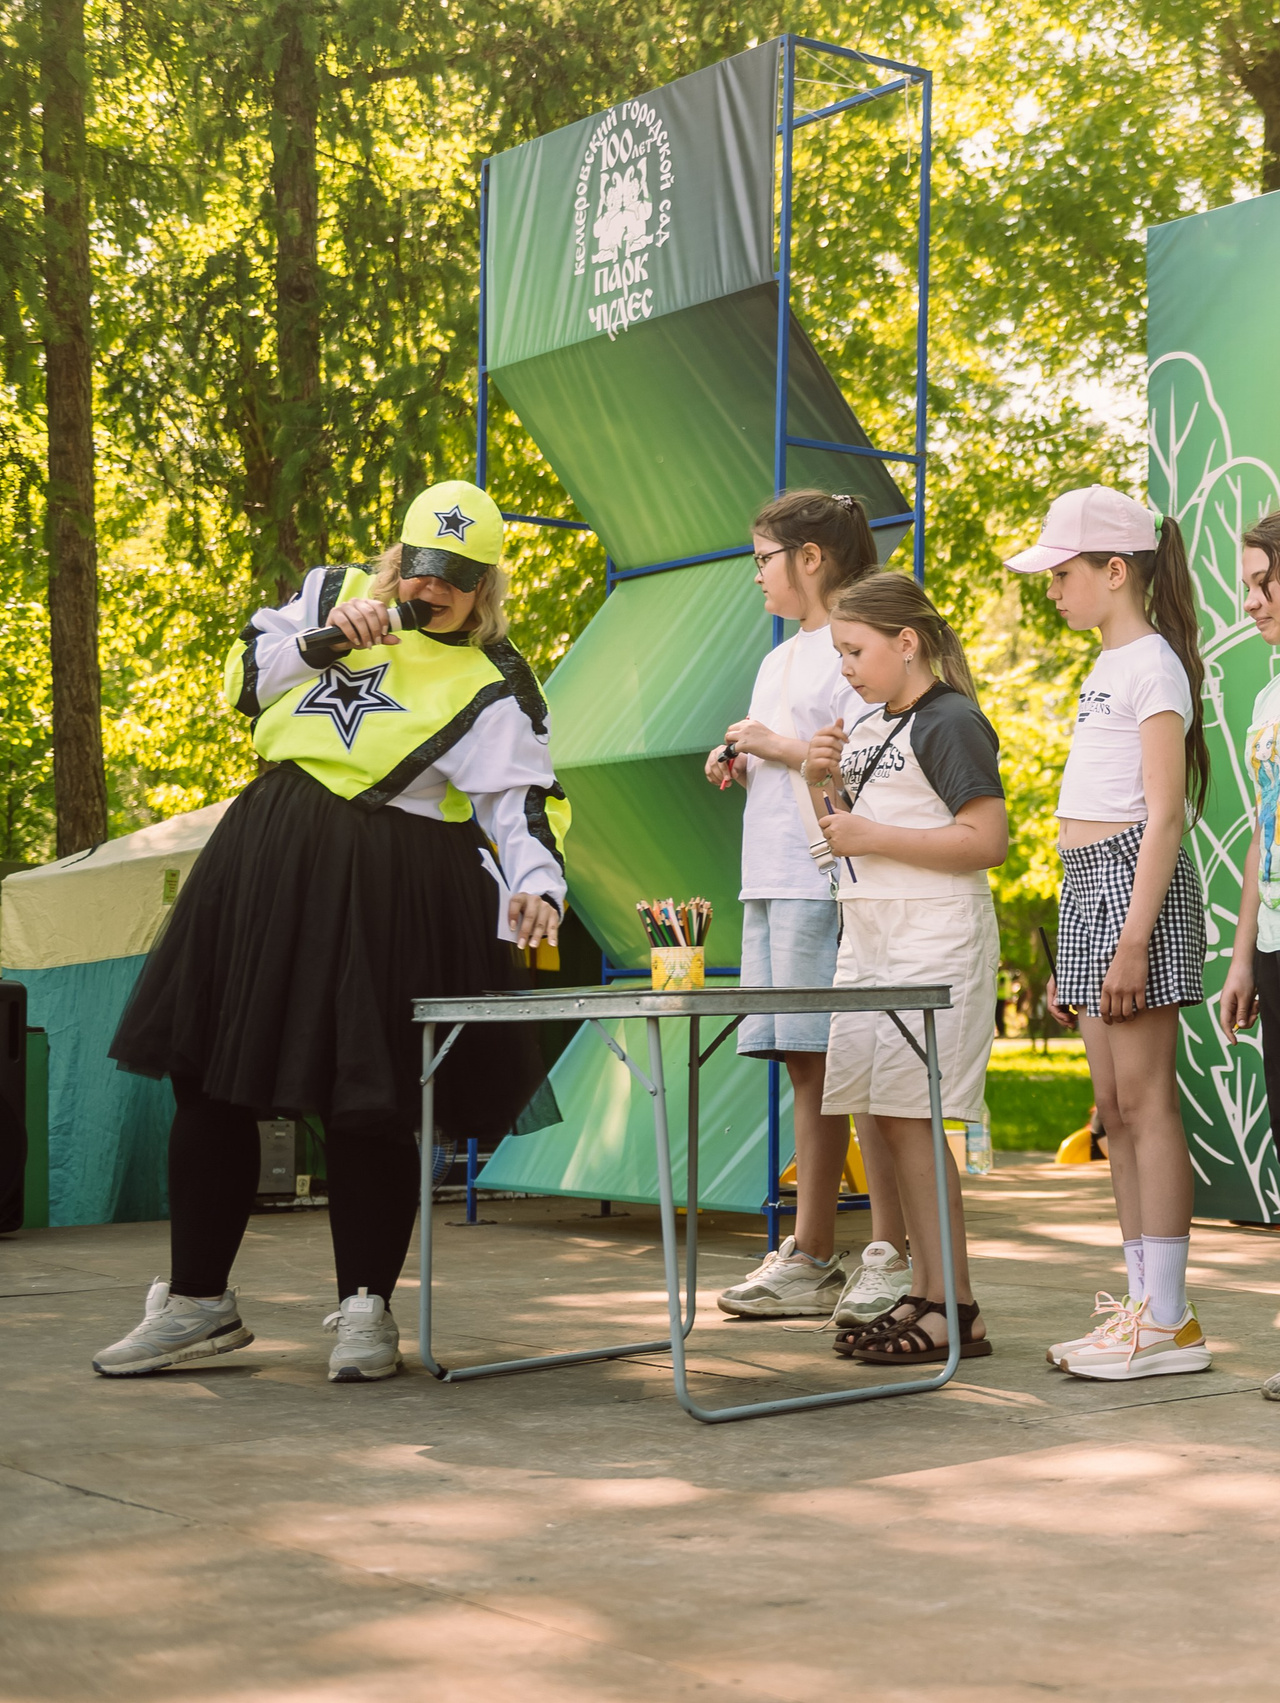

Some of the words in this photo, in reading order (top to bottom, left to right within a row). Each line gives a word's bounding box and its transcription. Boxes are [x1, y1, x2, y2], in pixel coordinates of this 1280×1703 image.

[600, 128, 634, 172] 100
[631, 139, 653, 159] ЛЕТ
[575, 106, 618, 276] КЕМЕРОВСКИЙ
[621, 101, 675, 191] ГОРОДСКОЙ
[655, 199, 672, 248] САД
[594, 252, 649, 301] ПАРК
[588, 287, 653, 341] ЧУДЕС
